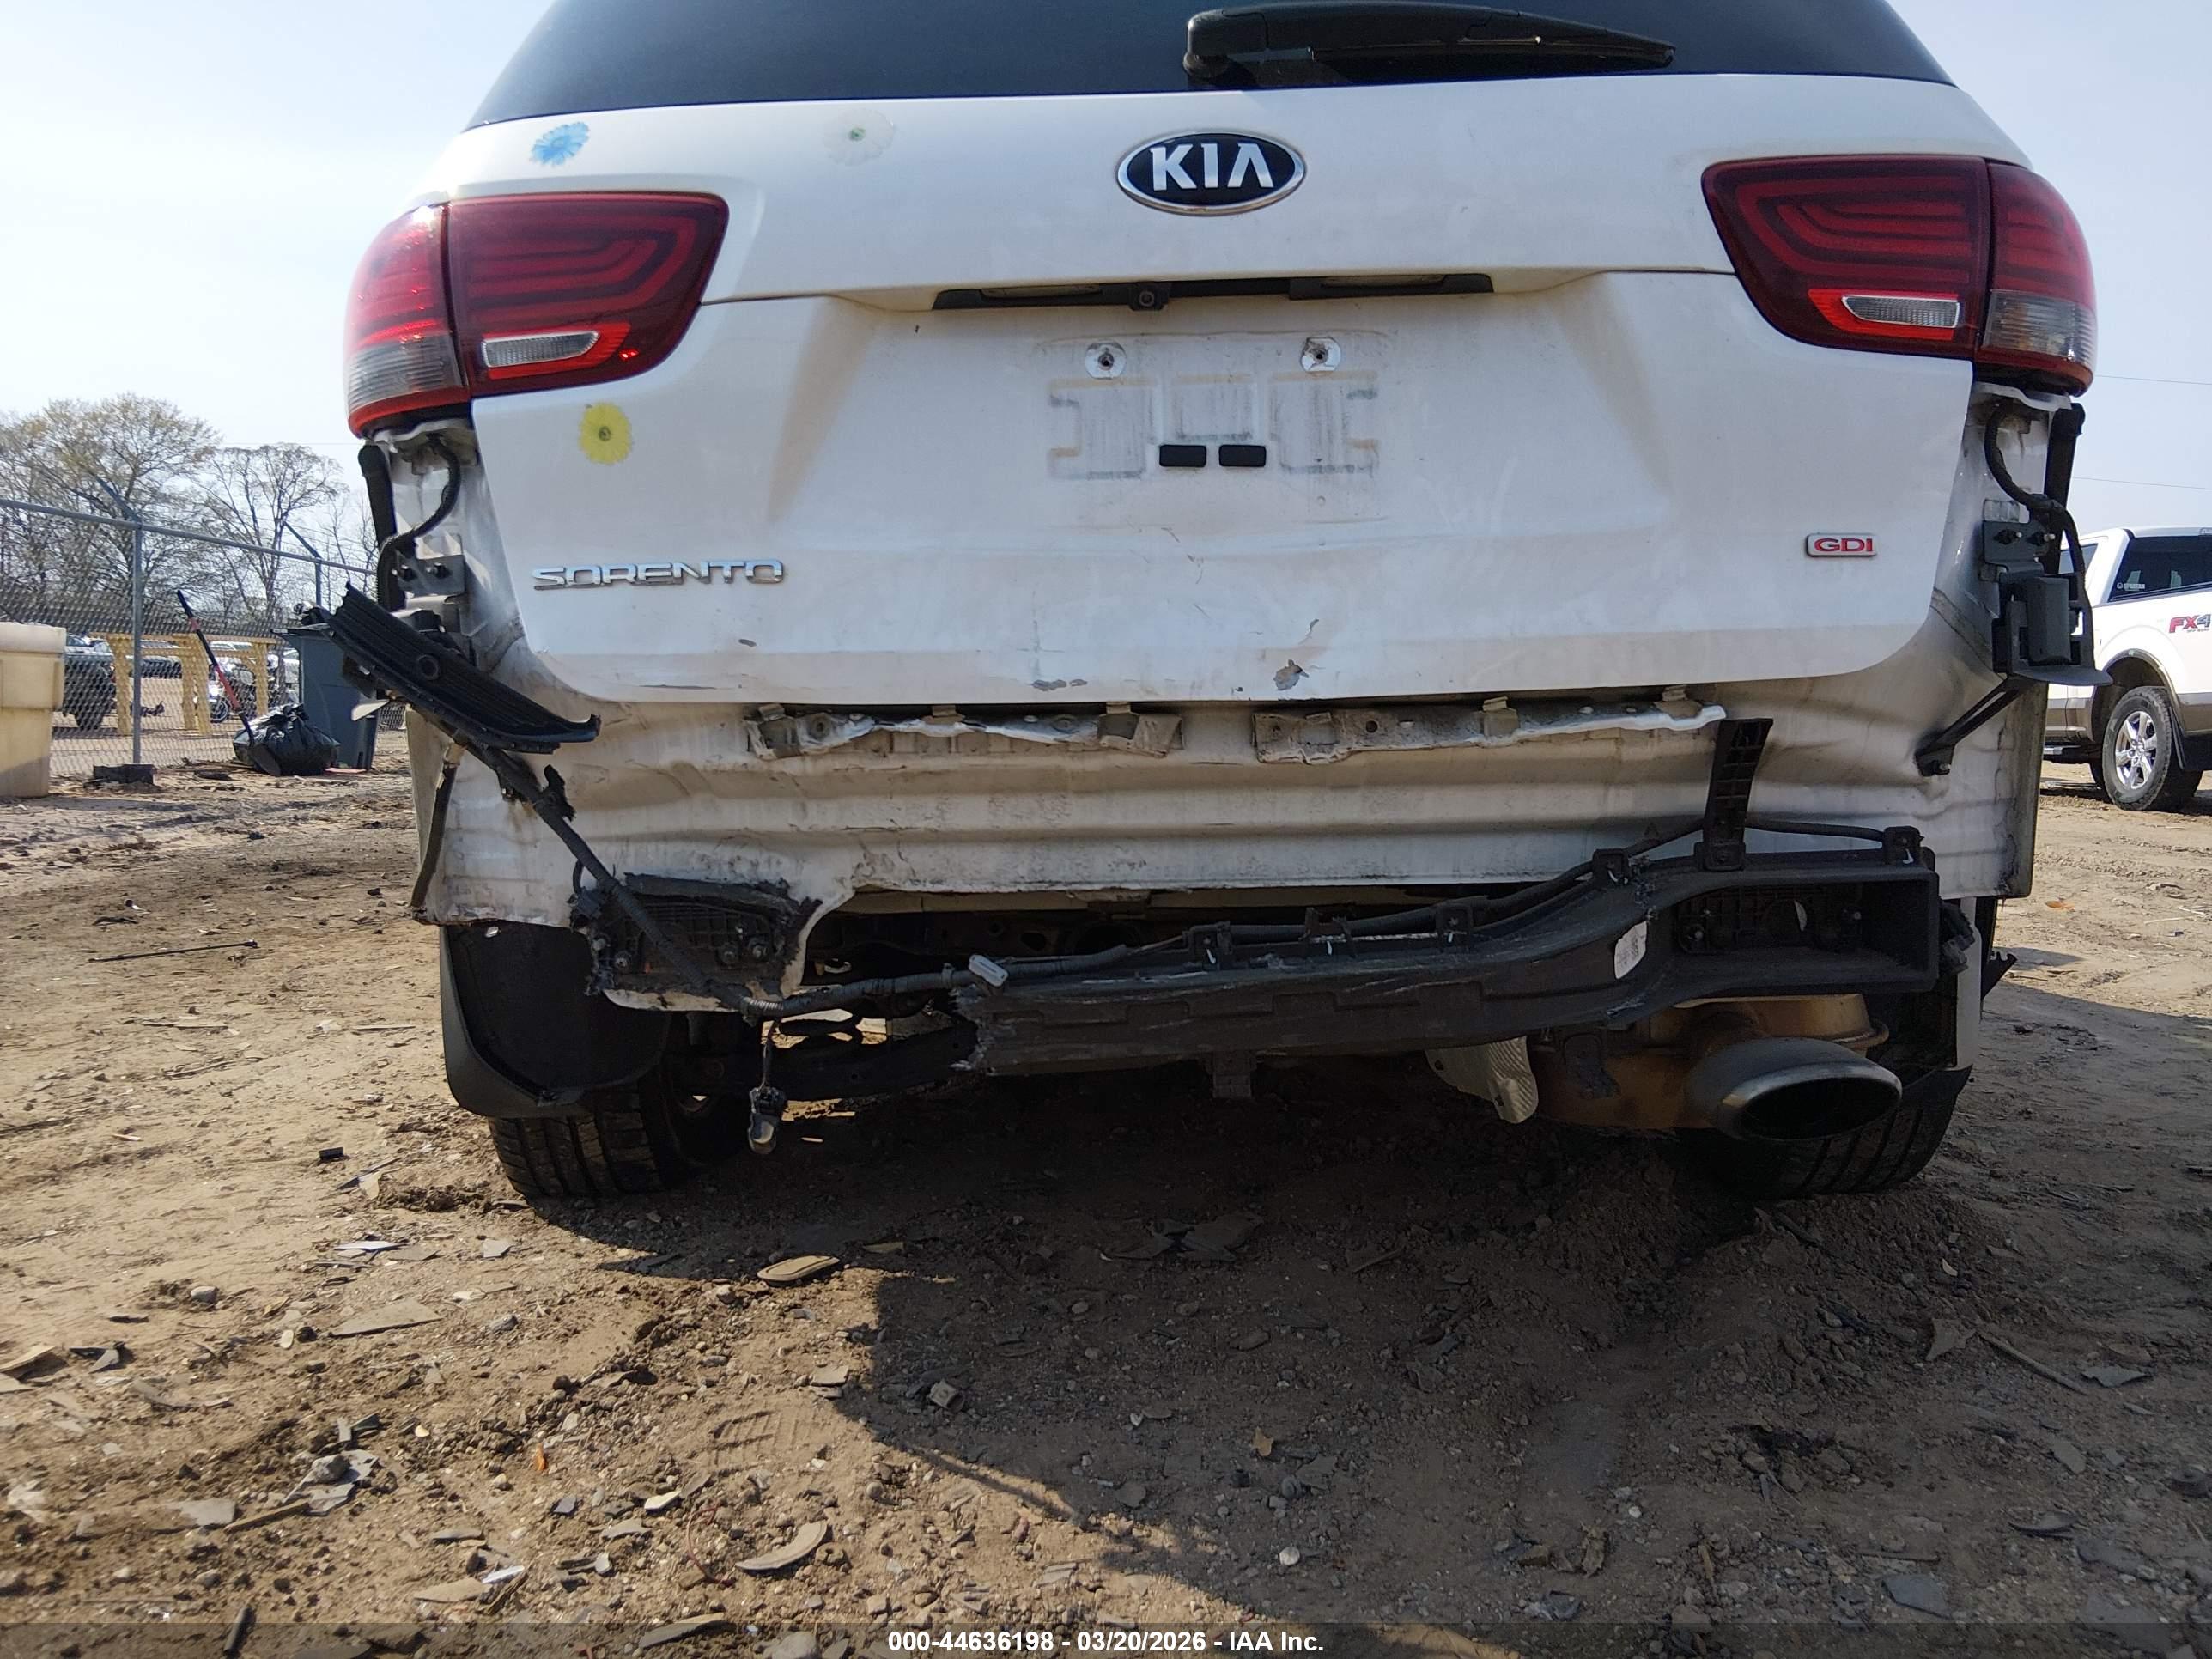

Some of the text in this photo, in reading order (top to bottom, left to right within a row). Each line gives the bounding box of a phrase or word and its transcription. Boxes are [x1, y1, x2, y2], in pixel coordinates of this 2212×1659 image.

[1150, 141, 1274, 191] KIA
[1814, 538, 1874, 553] GDI
[532, 558, 786, 590] SORENTO
[2169, 614, 2212, 633] FX4
